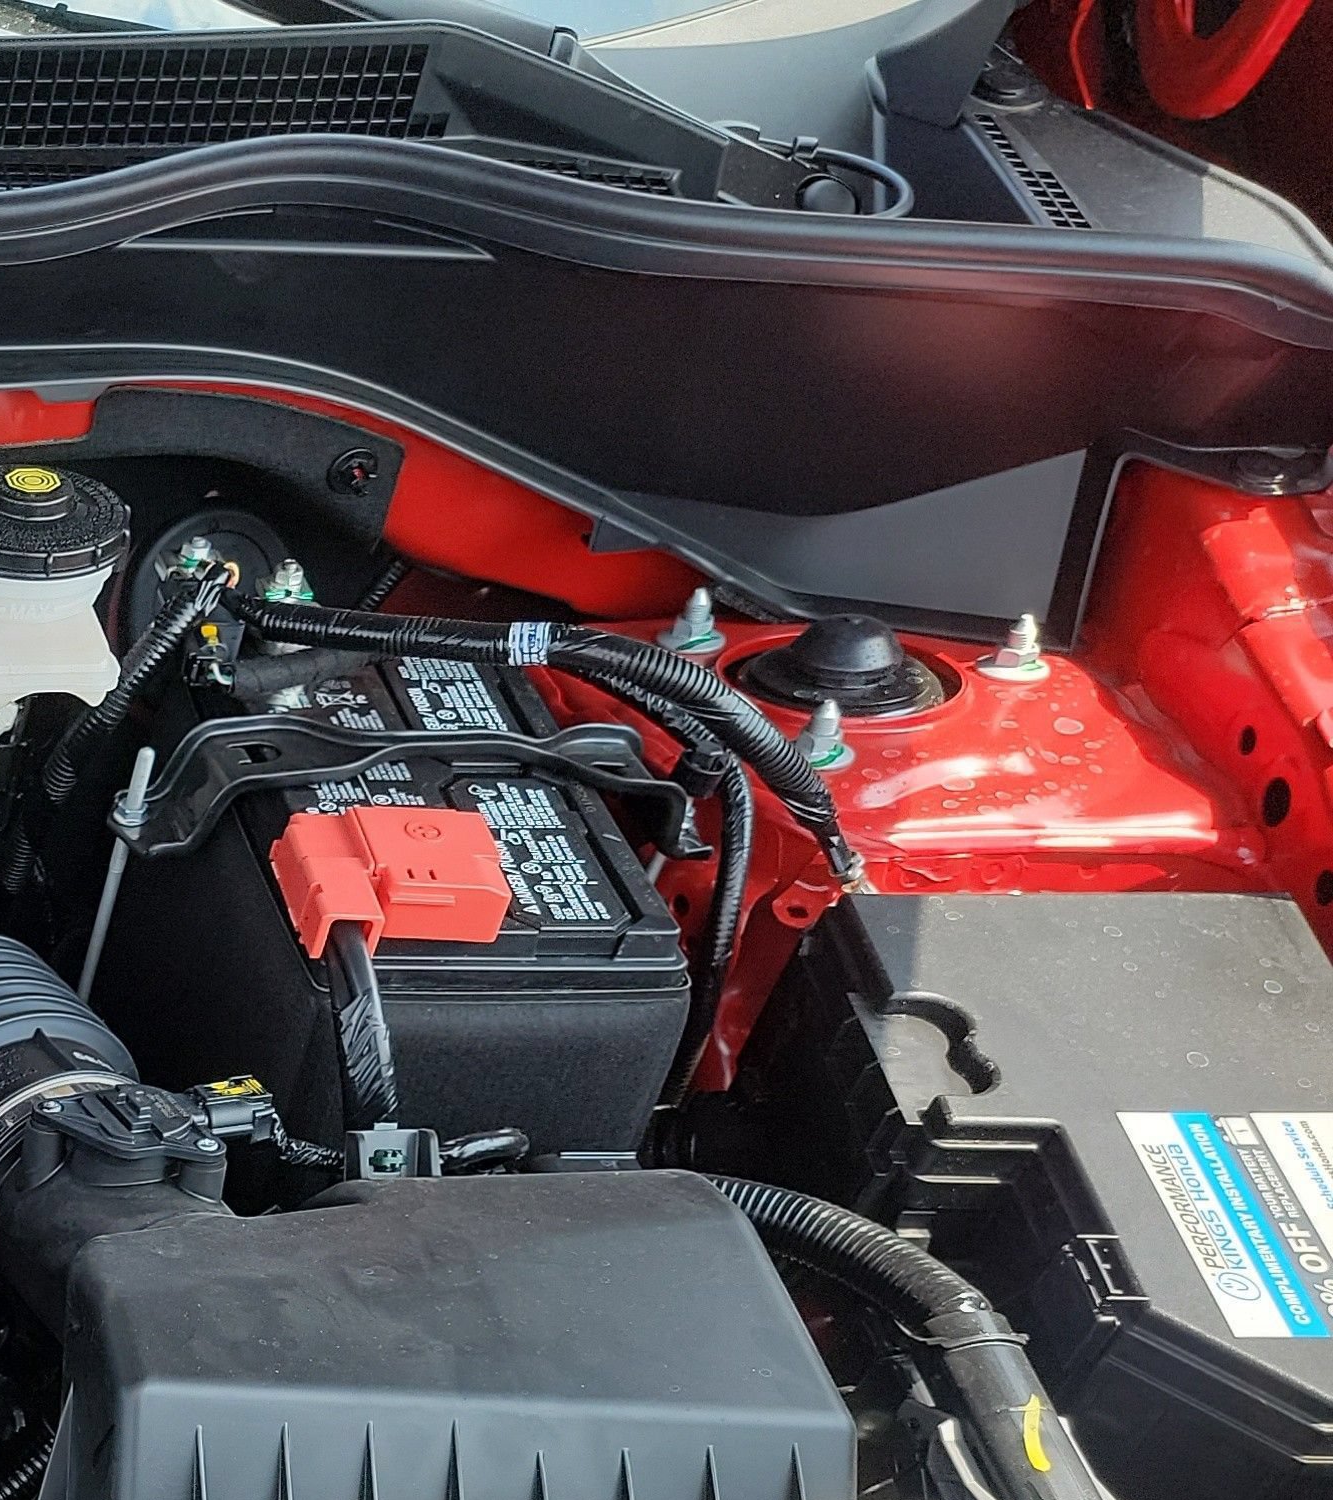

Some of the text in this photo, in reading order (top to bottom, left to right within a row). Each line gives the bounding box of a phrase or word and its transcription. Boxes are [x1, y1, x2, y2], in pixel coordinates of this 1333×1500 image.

[1282, 1121, 1310, 1160] Service
[1142, 1143, 1225, 1270] PERFORMANCE
[1167, 1143, 1247, 1269] KINGS Honda
[1236, 1149, 1286, 1219] YOUR BATTERY
[1252, 1149, 1301, 1219] REPLACEMENT
[1188, 1122, 1311, 1325] COMPLIMENTARY INSTALLATION
[1279, 1222, 1330, 1273] OFF
